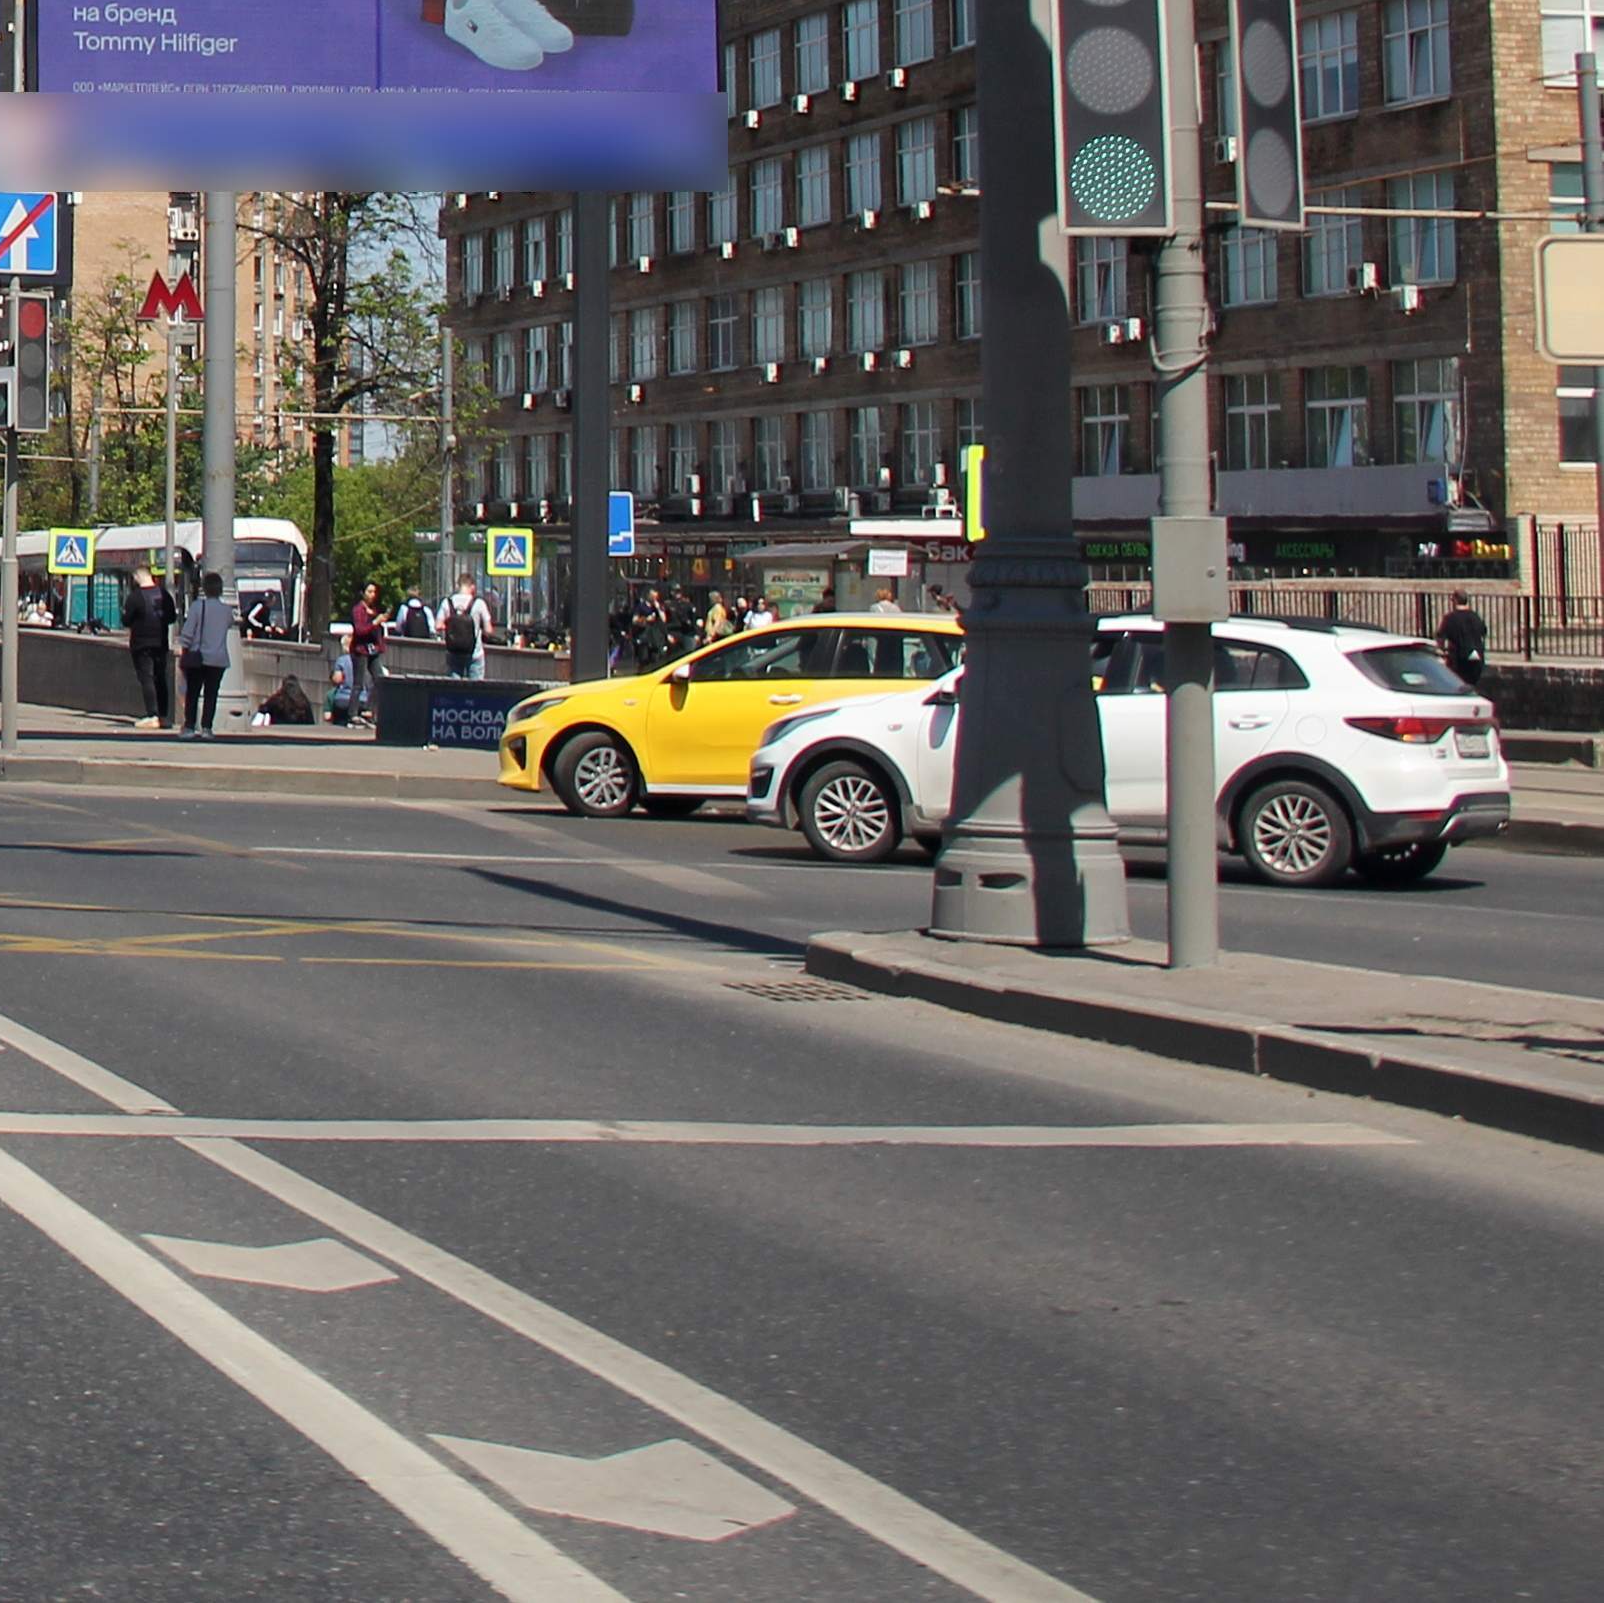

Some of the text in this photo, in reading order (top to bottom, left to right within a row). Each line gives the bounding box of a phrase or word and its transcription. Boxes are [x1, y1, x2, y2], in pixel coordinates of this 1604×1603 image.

[73, 3, 177, 26] на бренд
[73, 32, 238, 56] Tommy Hilfiger
[137, 268, 205, 318] М
[432, 708, 505, 725] МОСКВА
[432, 725, 456, 739] НА
